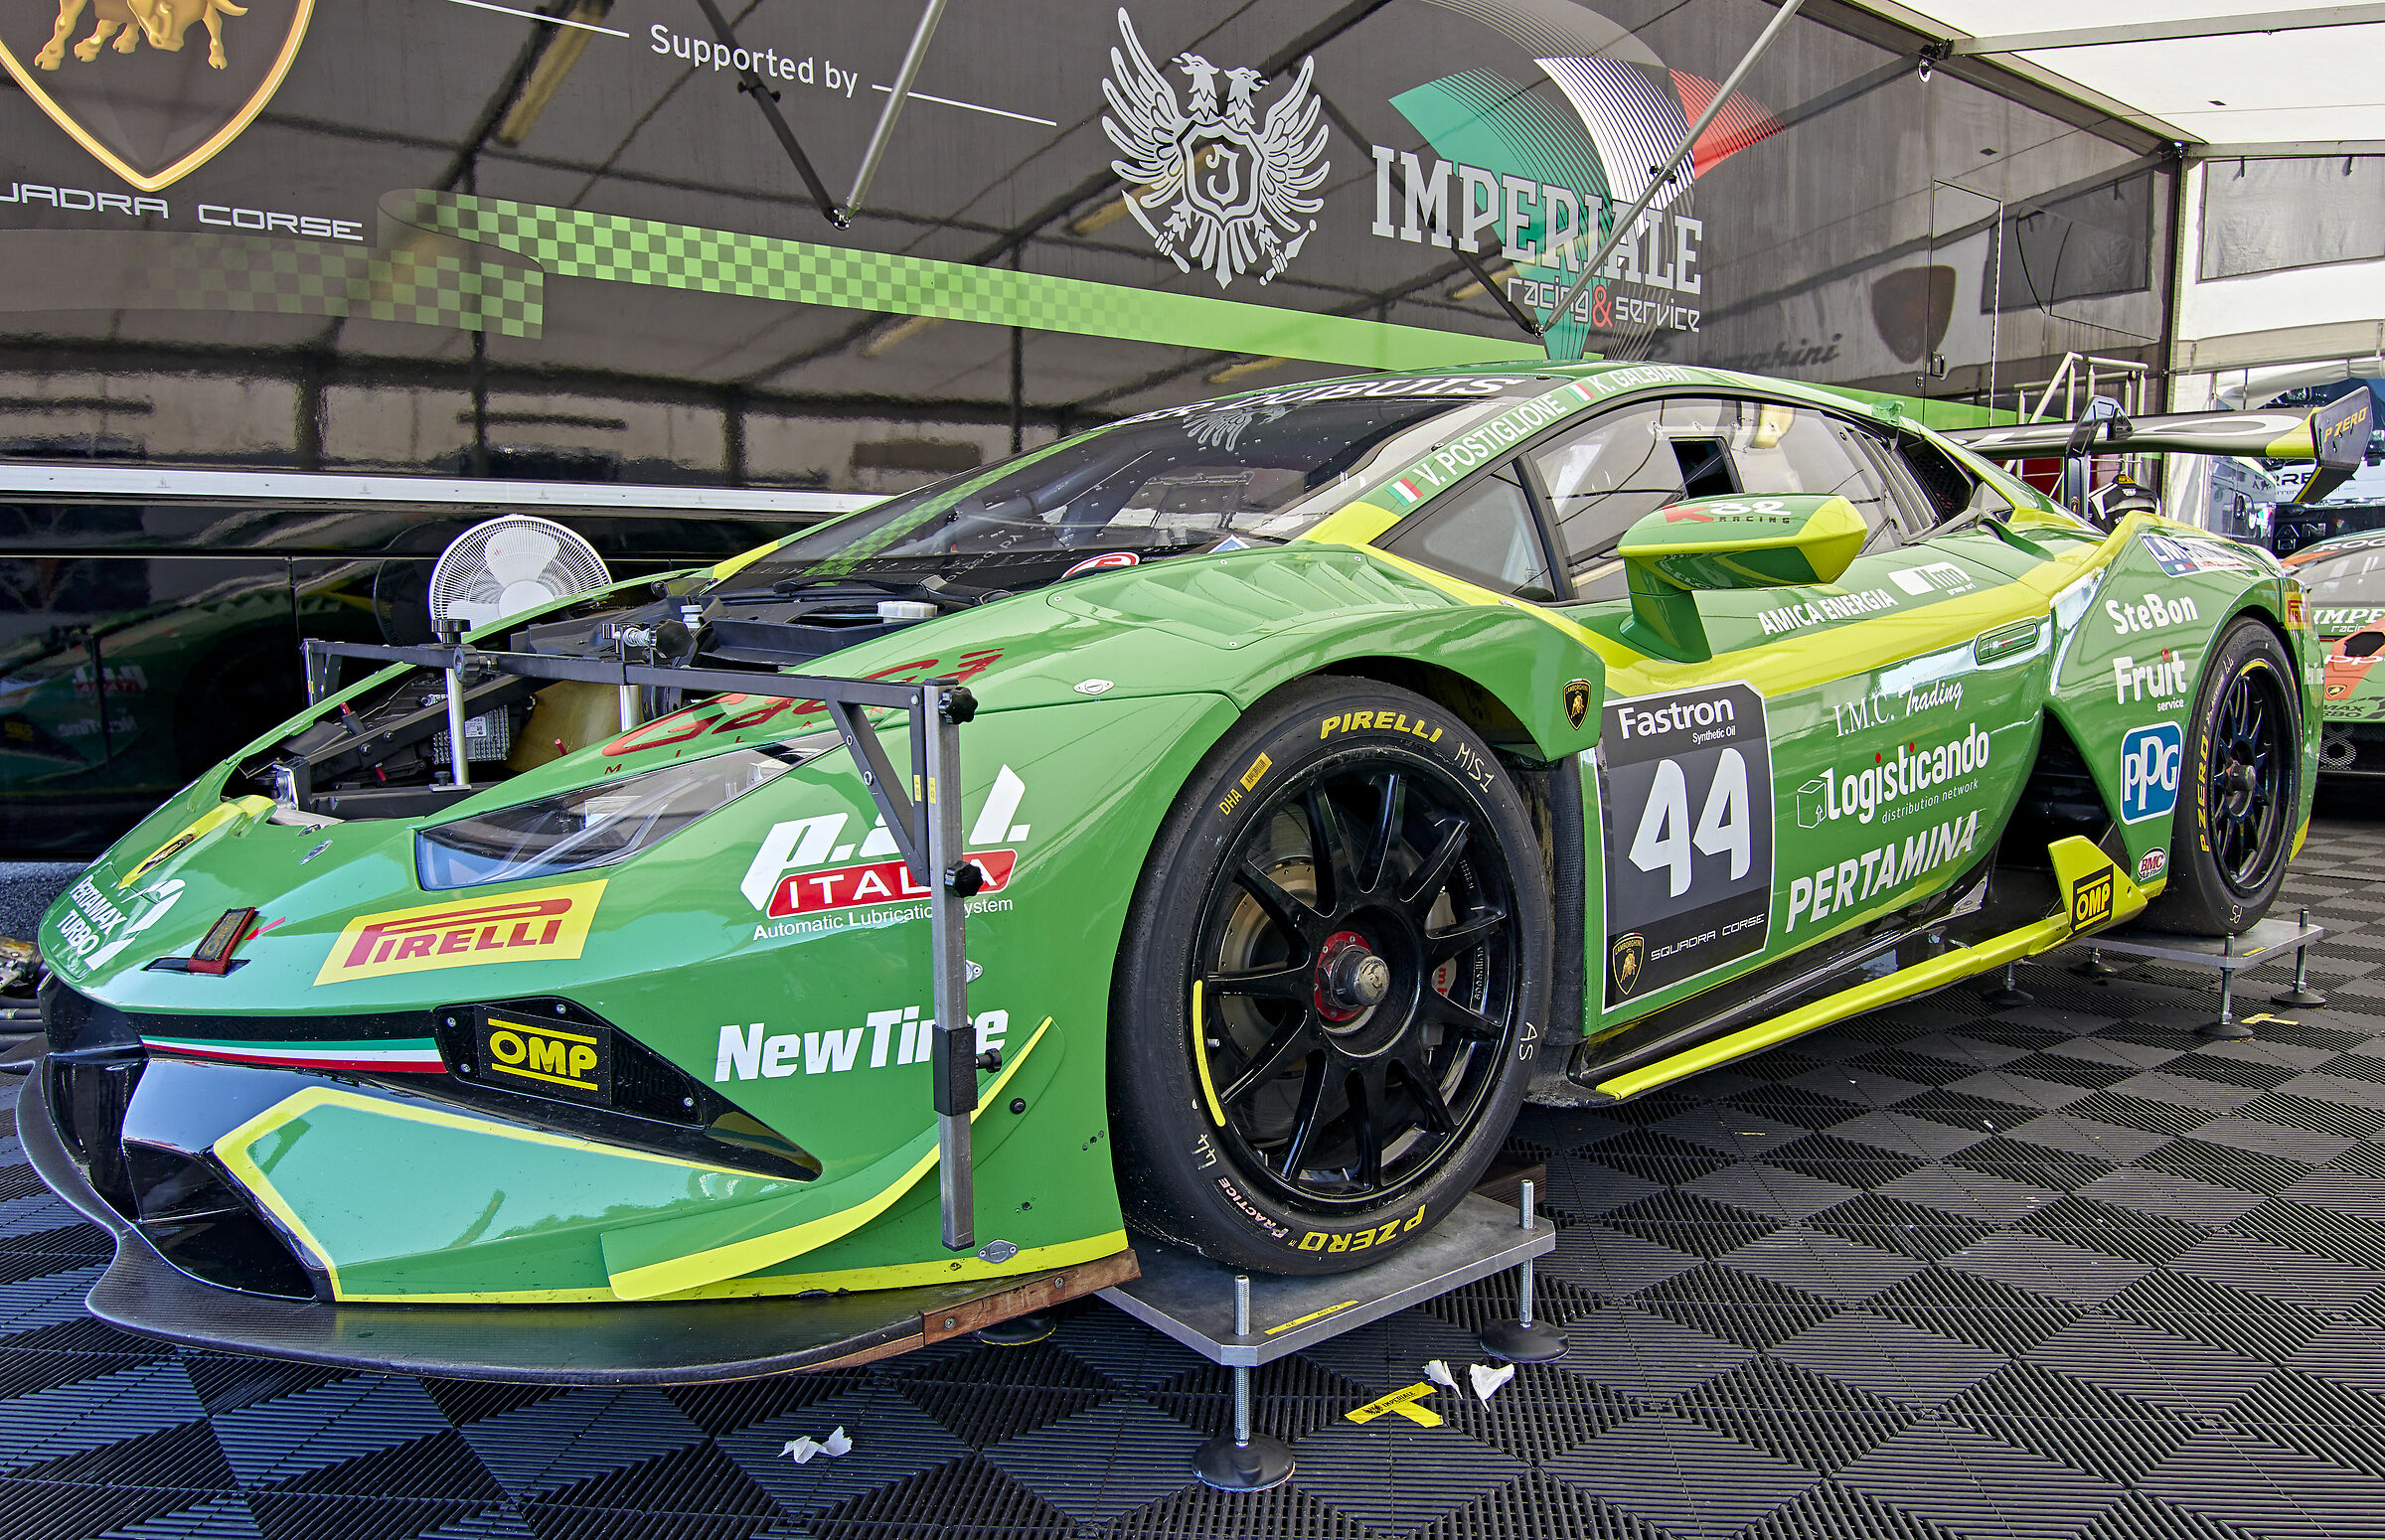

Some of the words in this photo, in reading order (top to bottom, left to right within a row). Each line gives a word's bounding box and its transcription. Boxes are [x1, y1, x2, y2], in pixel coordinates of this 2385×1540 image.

[650, 24, 815, 85] Supported
[824, 60, 859, 98] by
[198, 203, 364, 241] CORSE
[1371, 144, 1702, 295] IMPERIALE
[1209, 378, 1526, 412] DUBUIS
[1588, 375, 1609, 395] K.
[1611, 365, 1693, 387] GALBIATI
[1412, 463, 1444, 488] V.
[1435, 393, 1570, 475] POSTIGLIONE
[2334, 406, 2369, 437] ZERO
[1718, 516, 1791, 526] RACING
[1757, 603, 1826, 636] AMICA
[1818, 588, 1899, 621] ENERGIA
[2105, 593, 2198, 634] SteBon
[2113, 648, 2186, 704] Fruit
[1619, 697, 1734, 740] Fastron
[1832, 692, 1895, 738] I.M.C.
[1898, 680, 1965, 716] Trading
[2156, 697, 2184, 712] service
[1320, 710, 1443, 743] PIRELLI
[1692, 729, 1724, 744] Synthetic
[1726, 726, 1736, 737] Oil
[1218, 788, 1243, 816] DHA
[1882, 795, 1939, 824] distribution
[1942, 779, 1979, 802] network
[2197, 741, 2209, 828] ZERO
[1628, 747, 1751, 898] 44
[2141, 854, 2164, 872] BMC
[2199, 840, 2210, 853] P
[789, 858, 997, 909] ITALA
[1785, 810, 1979, 934] PERTAMINA
[70, 874, 127, 935] PERTAMAX
[753, 916, 844, 942] Automatic
[848, 903, 933, 926] Lubricatio
[965, 898, 1014, 916] ystem
[2076, 882, 2111, 921] OMP
[56, 908, 99, 955] TURBO
[343, 897, 573, 969] PIRELLI
[1650, 930, 1716, 961] SQUADRA
[1722, 913, 1765, 936] CORSE
[489, 1030, 597, 1072] OMP
[1519, 1020, 1540, 1062] AS
[1192, 1134, 1217, 1170] 44
[1218, 1177, 1289, 1239] PRACTICE
[1404, 1204, 1426, 1232] P
[1297, 1219, 1401, 1253] ZERO
